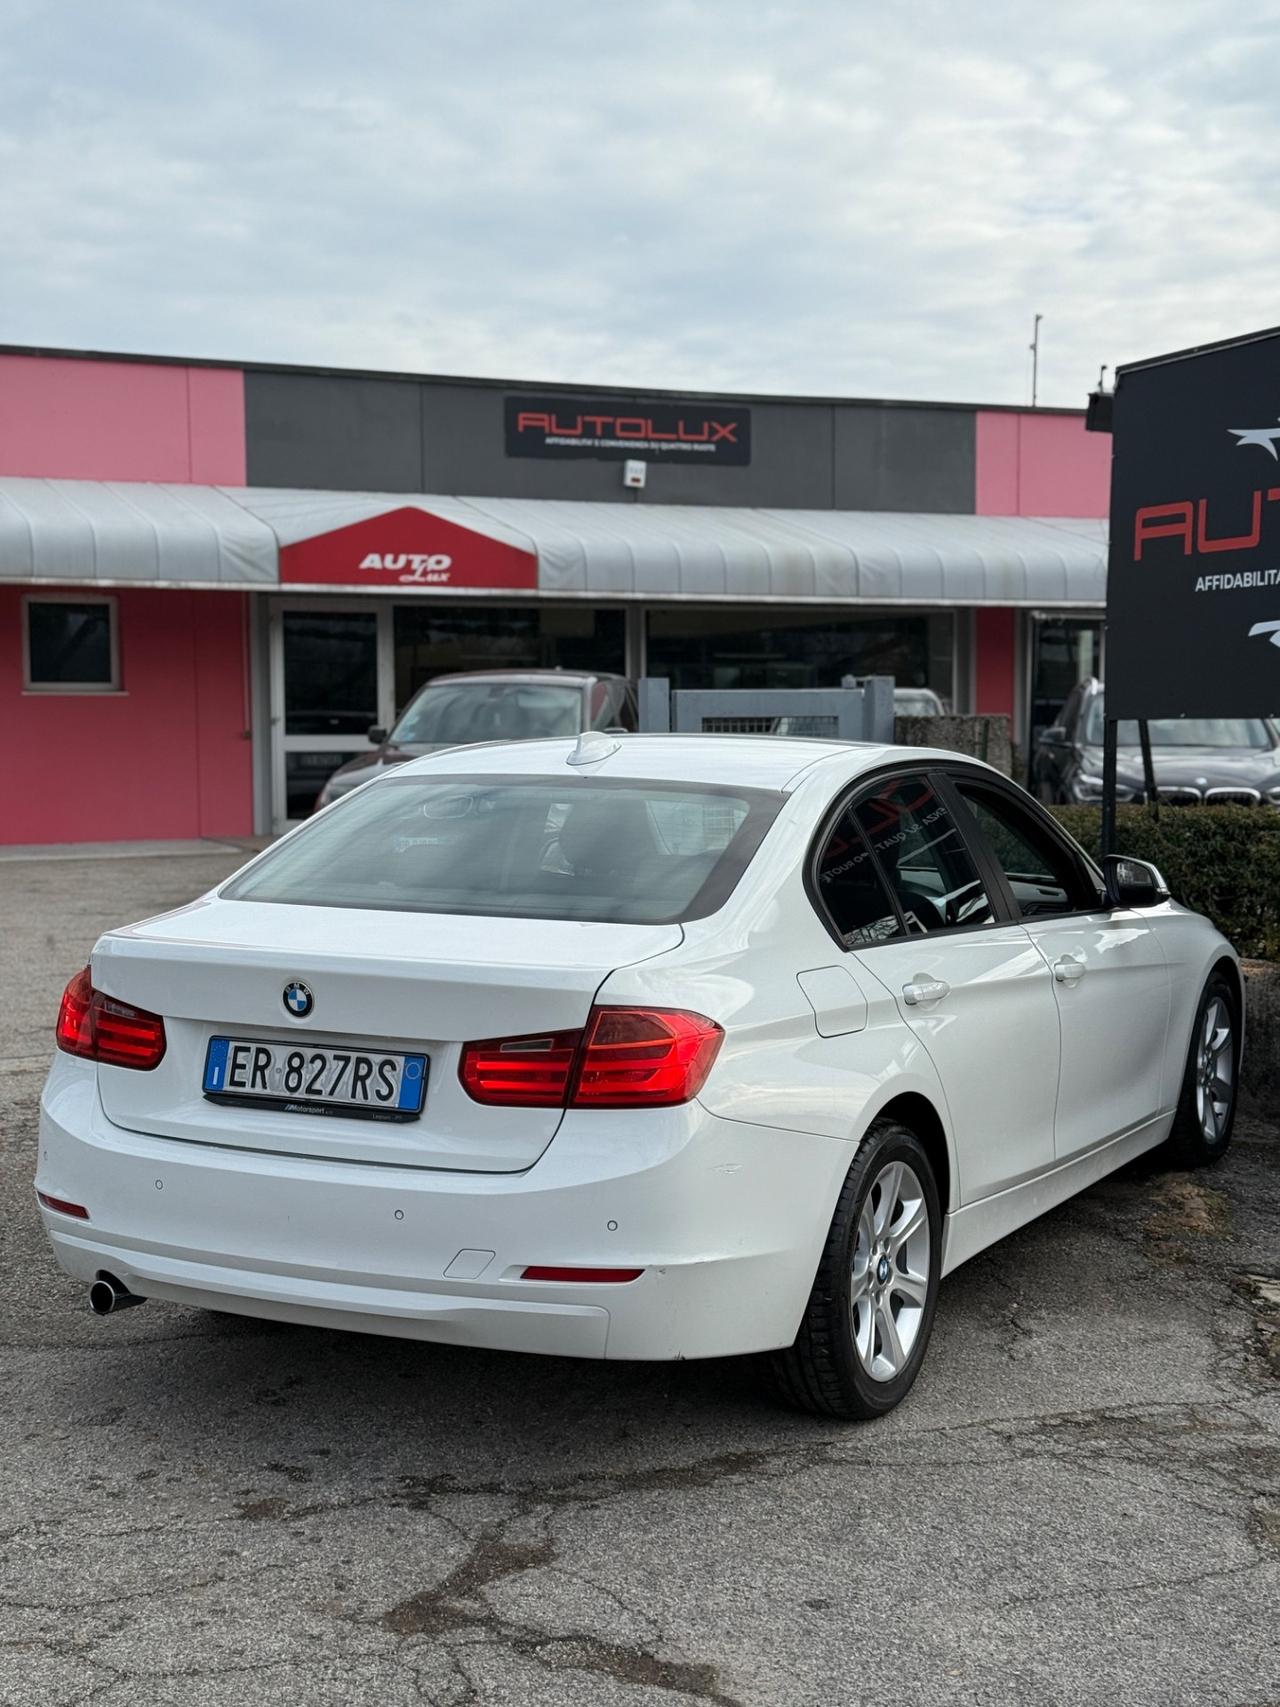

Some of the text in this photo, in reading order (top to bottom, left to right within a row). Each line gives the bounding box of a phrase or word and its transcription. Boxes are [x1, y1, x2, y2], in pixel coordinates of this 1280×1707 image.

[517, 412, 738, 443] AUTOLUX
[1134, 487, 1280, 561] AU
[358, 553, 452, 571] AUTO
[228, 1045, 398, 1102] ER 827RS
